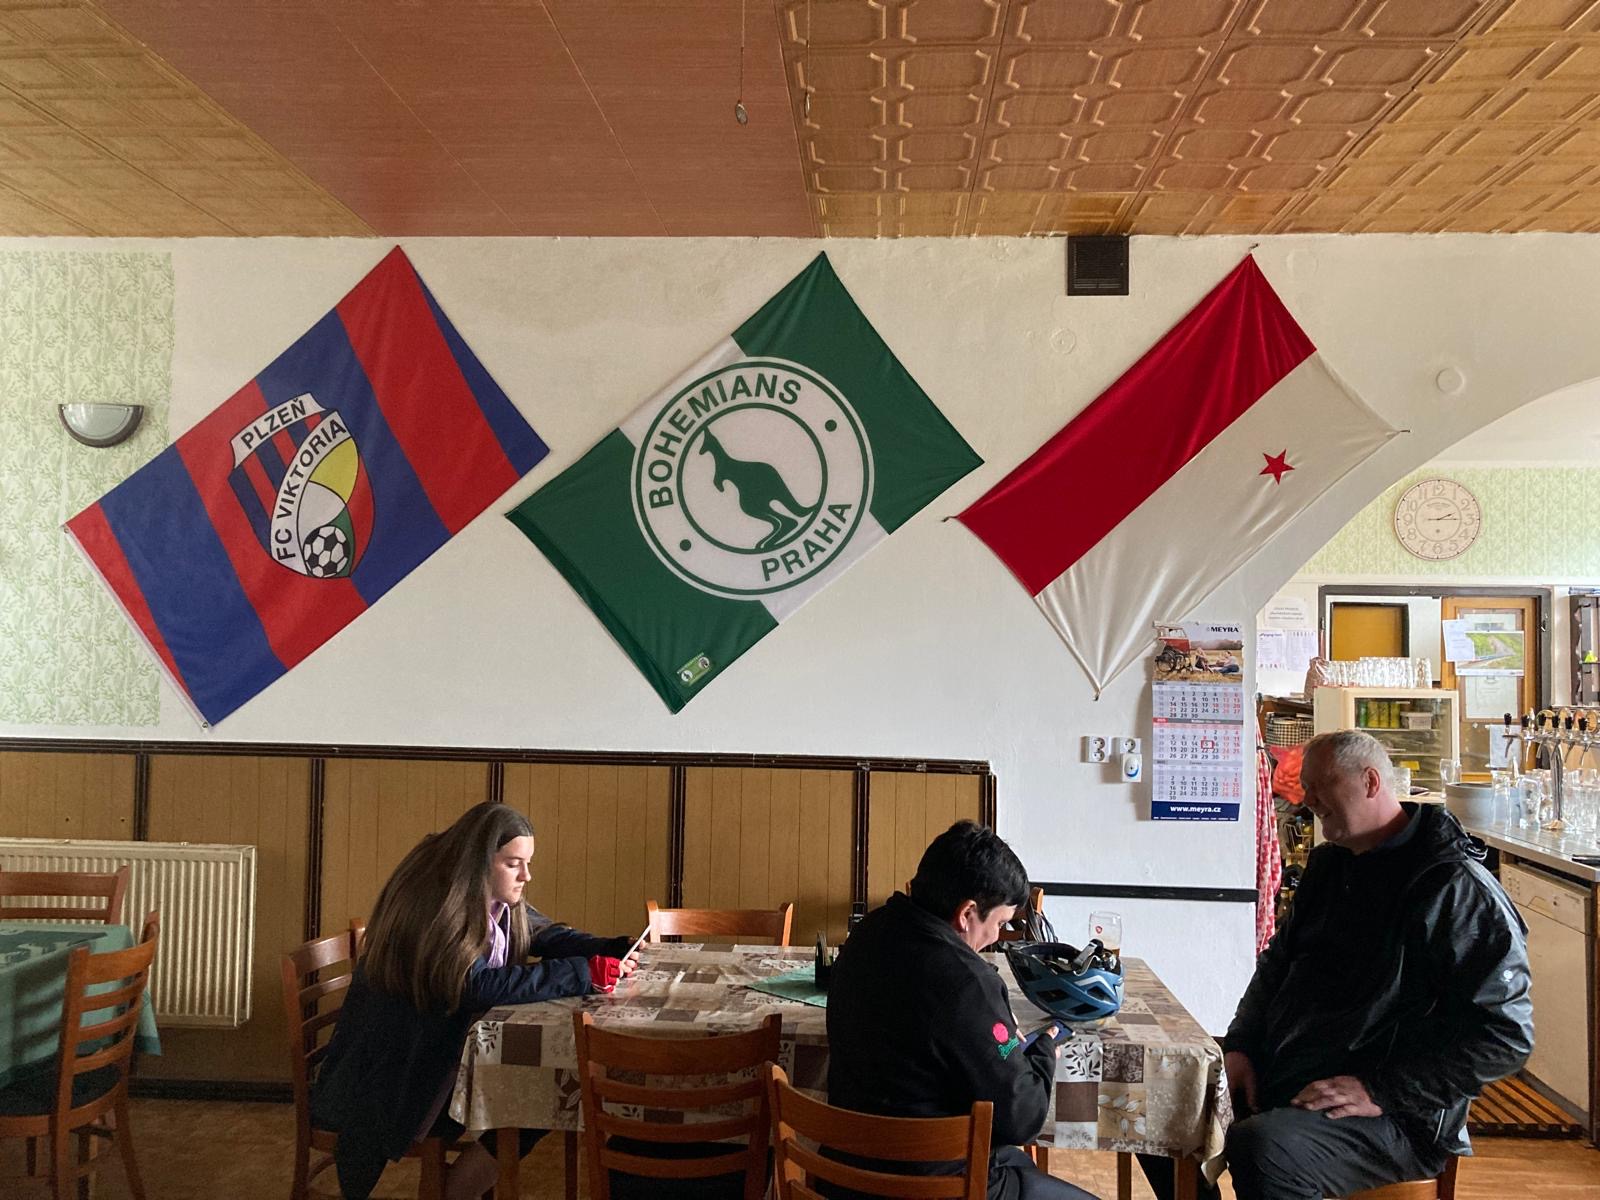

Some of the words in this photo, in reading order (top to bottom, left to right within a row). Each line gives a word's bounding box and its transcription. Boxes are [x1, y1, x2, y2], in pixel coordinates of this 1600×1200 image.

[241, 398, 306, 449] PLZEŇ
[648, 373, 802, 509] BOHEMIANS
[276, 419, 347, 519] VIKTORIA
[274, 528, 296, 561] FC
[761, 503, 852, 582] PRAHA
